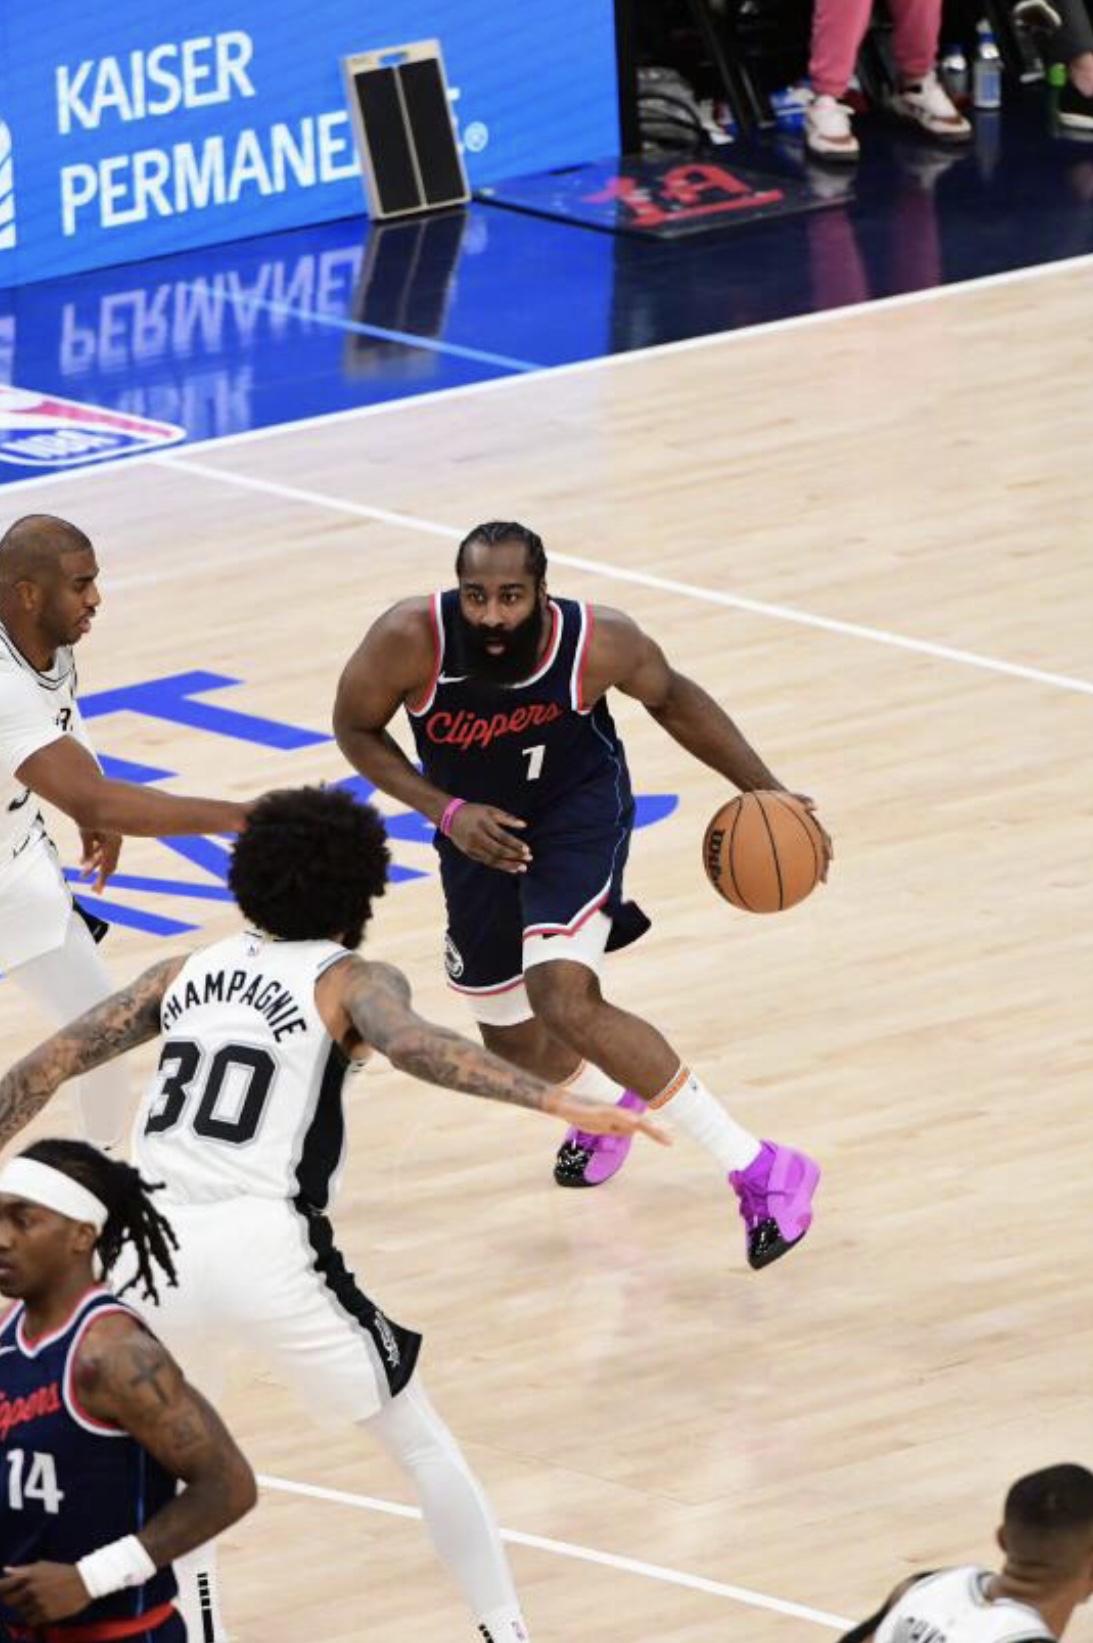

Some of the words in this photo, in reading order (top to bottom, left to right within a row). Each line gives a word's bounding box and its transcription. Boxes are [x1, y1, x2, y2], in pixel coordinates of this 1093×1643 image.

[57, 31, 256, 135] KAISER
[61, 88, 464, 236] PERMANE
[426, 702, 563, 750] Clippers
[521, 744, 546, 781] 1
[143, 1039, 279, 1147] 30
[6, 1448, 65, 1515] 14
